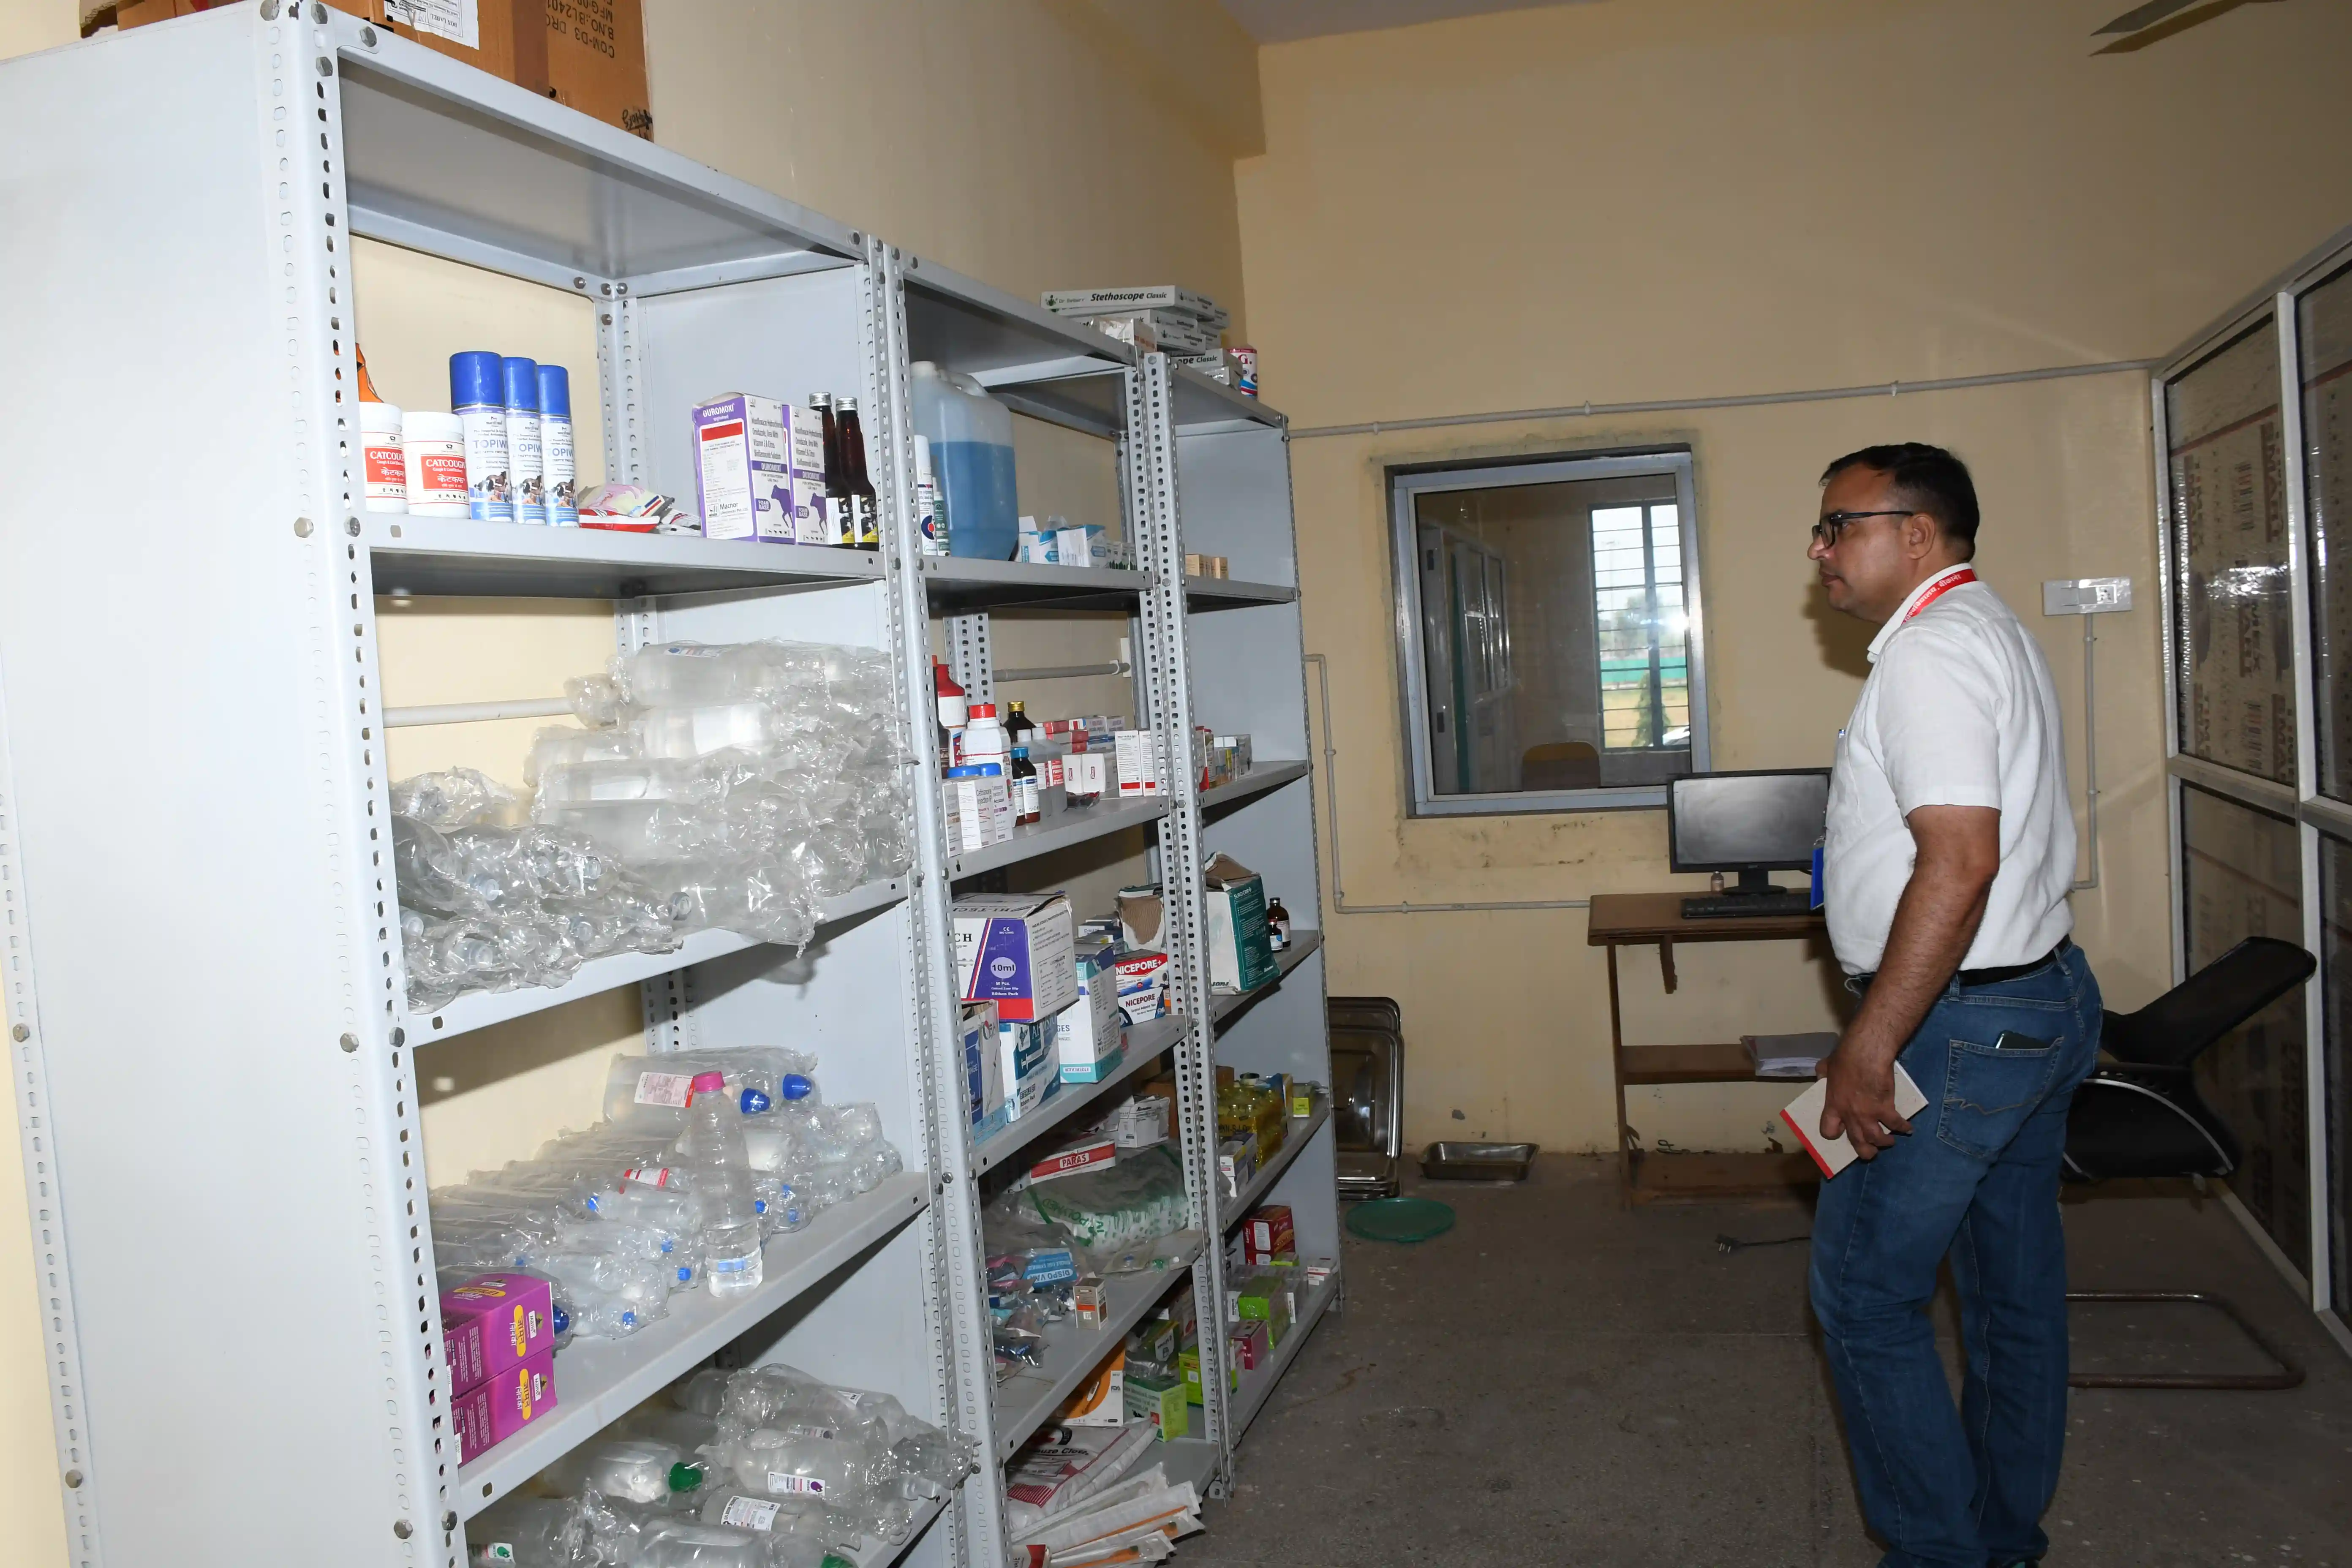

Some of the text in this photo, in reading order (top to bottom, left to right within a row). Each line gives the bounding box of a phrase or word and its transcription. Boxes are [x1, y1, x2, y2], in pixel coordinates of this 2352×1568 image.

[431, 14, 446, 23] LABEL
[448, 19, 457, 28] BOX
[575, 27, 615, 58] COM-D3
[1091, 292, 1144, 302] Stethoscope
[426, 459, 465, 468] CATCOUGH
[1125, 994, 1156, 1008] NICEPORE
[1062, 1154, 1086, 1167] PARAS
[1048, 1270, 1070, 1279] DISPO
